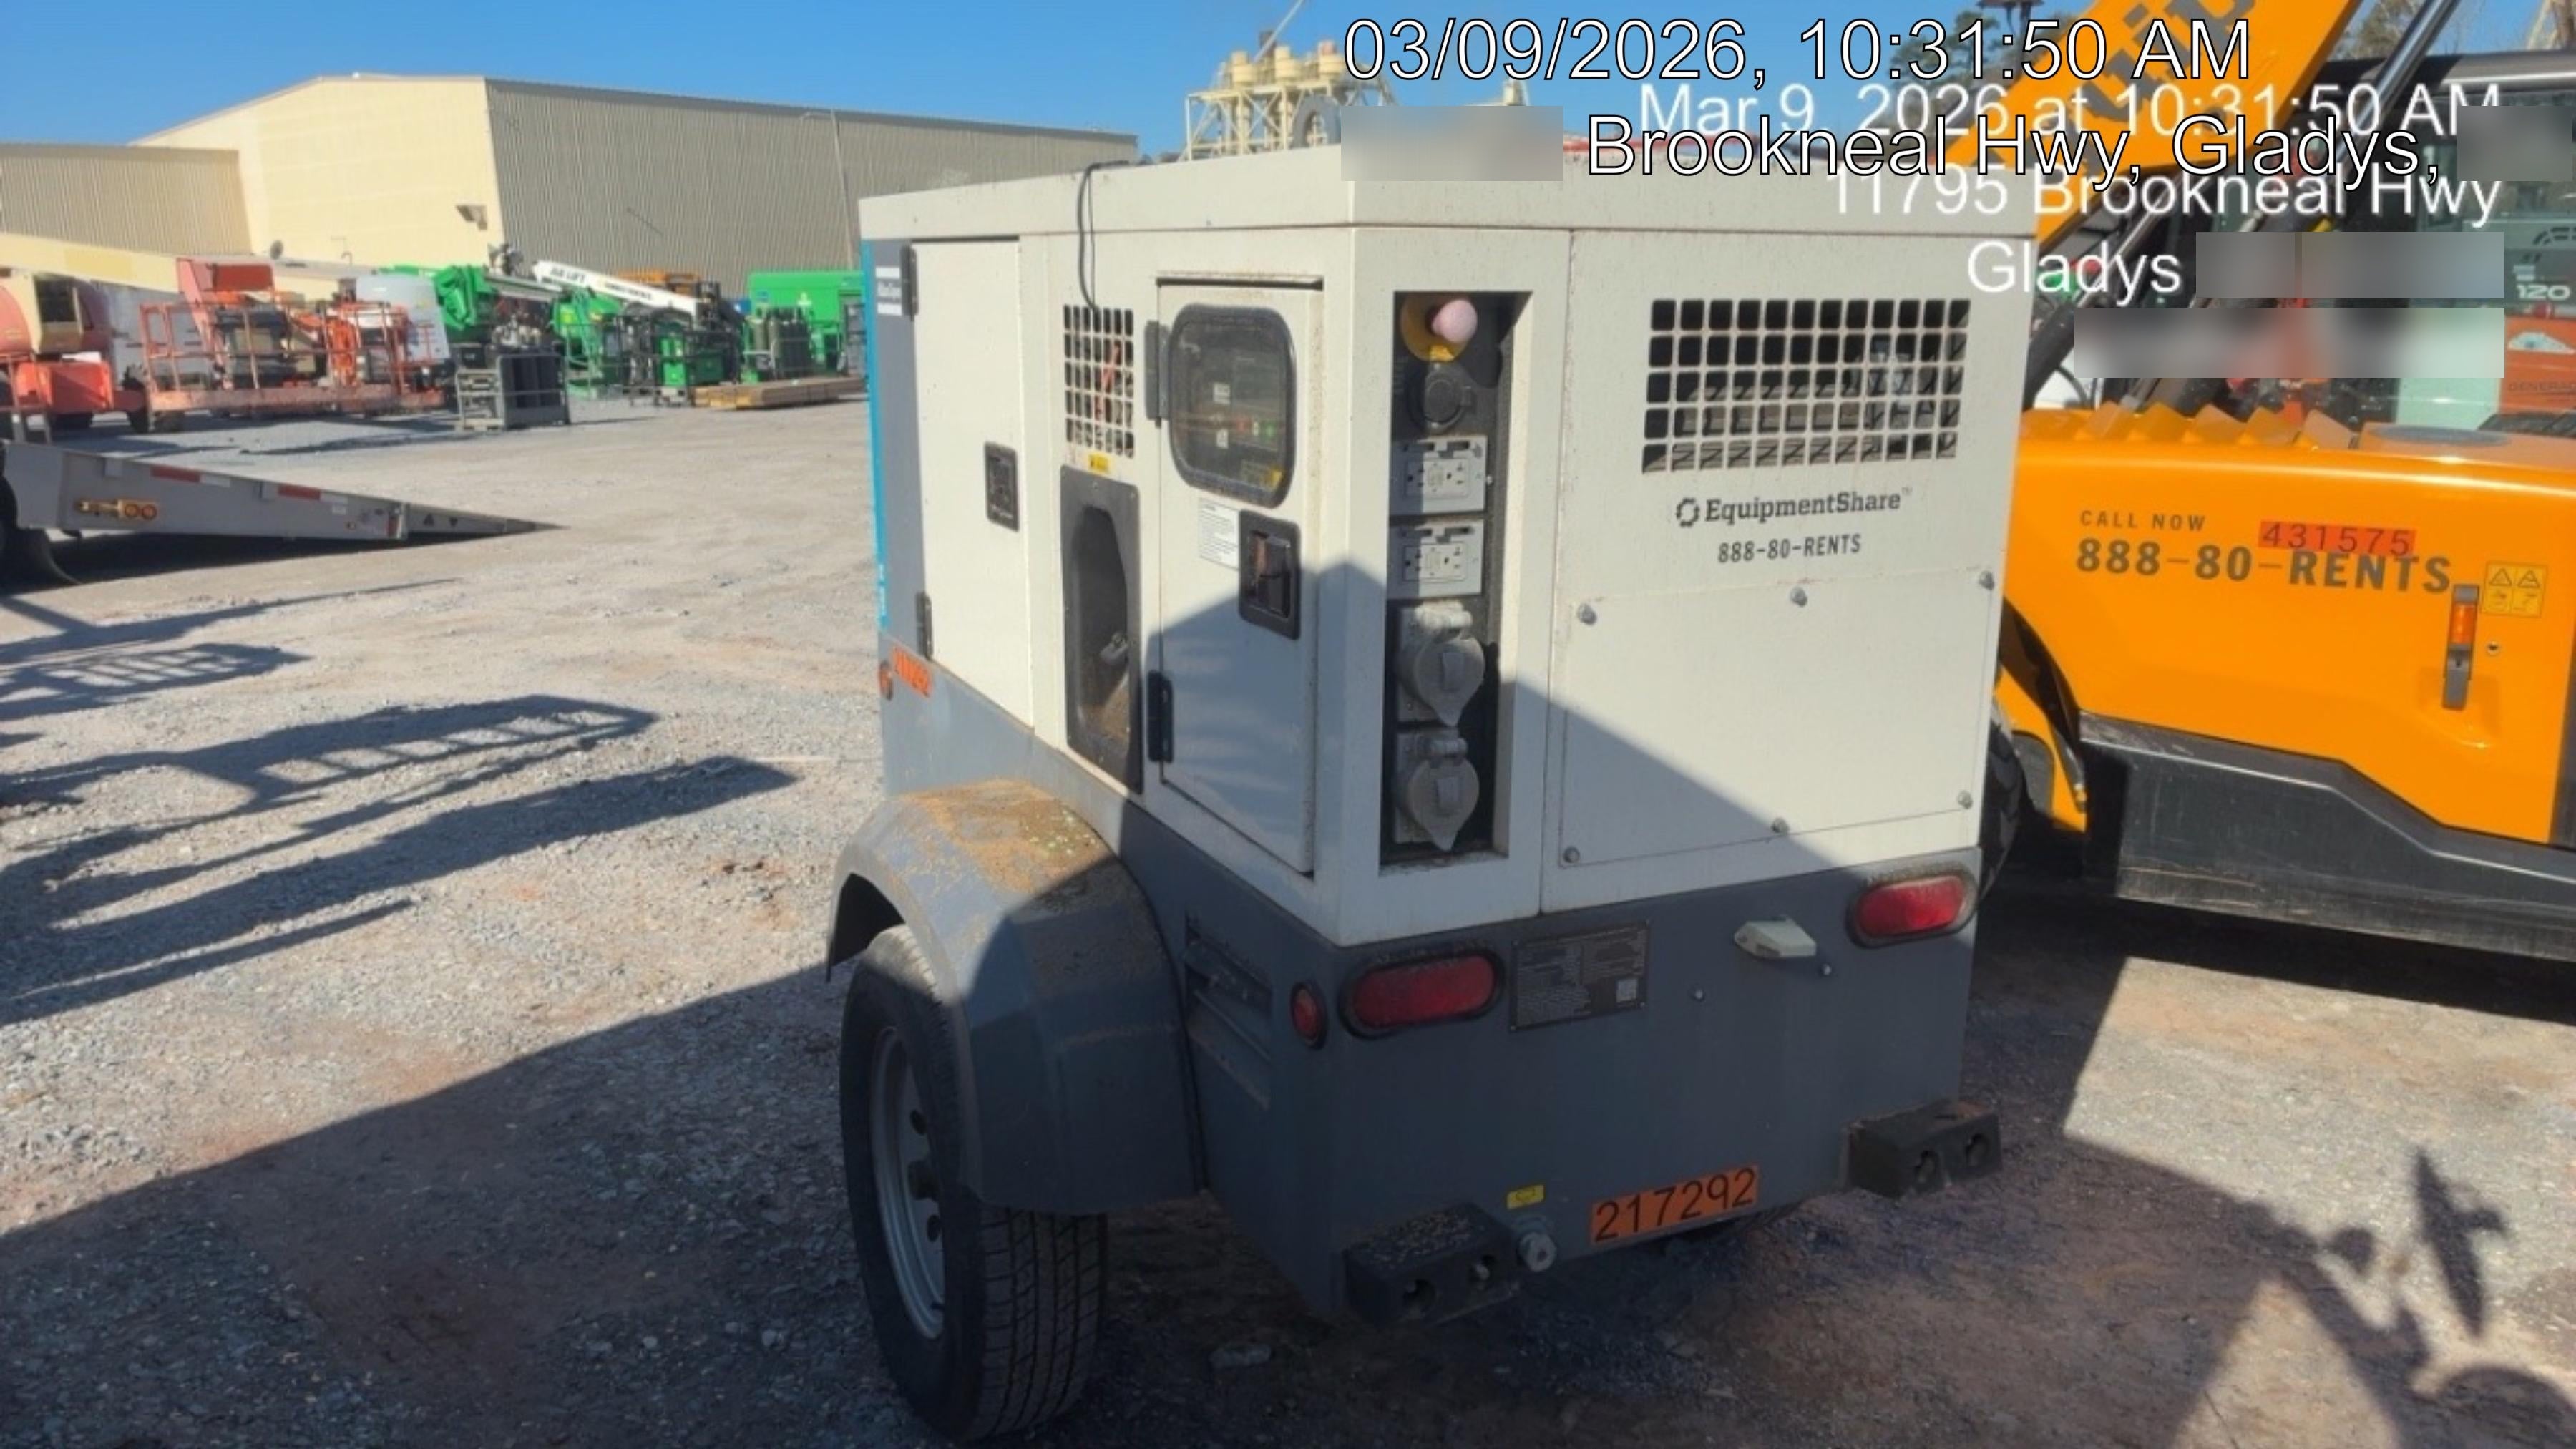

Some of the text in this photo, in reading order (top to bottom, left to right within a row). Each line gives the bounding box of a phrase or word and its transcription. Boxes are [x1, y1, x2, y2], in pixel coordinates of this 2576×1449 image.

[2517, 284, 2570, 300] 120
[2080, 510, 2205, 532] CALL NOW
[1718, 534, 1861, 563] 888-80-RENTS
[2262, 523, 2411, 555] 431575
[2077, 537, 2452, 594] 888-80-RENTS
[1594, 1167, 1755, 1242] 217292
